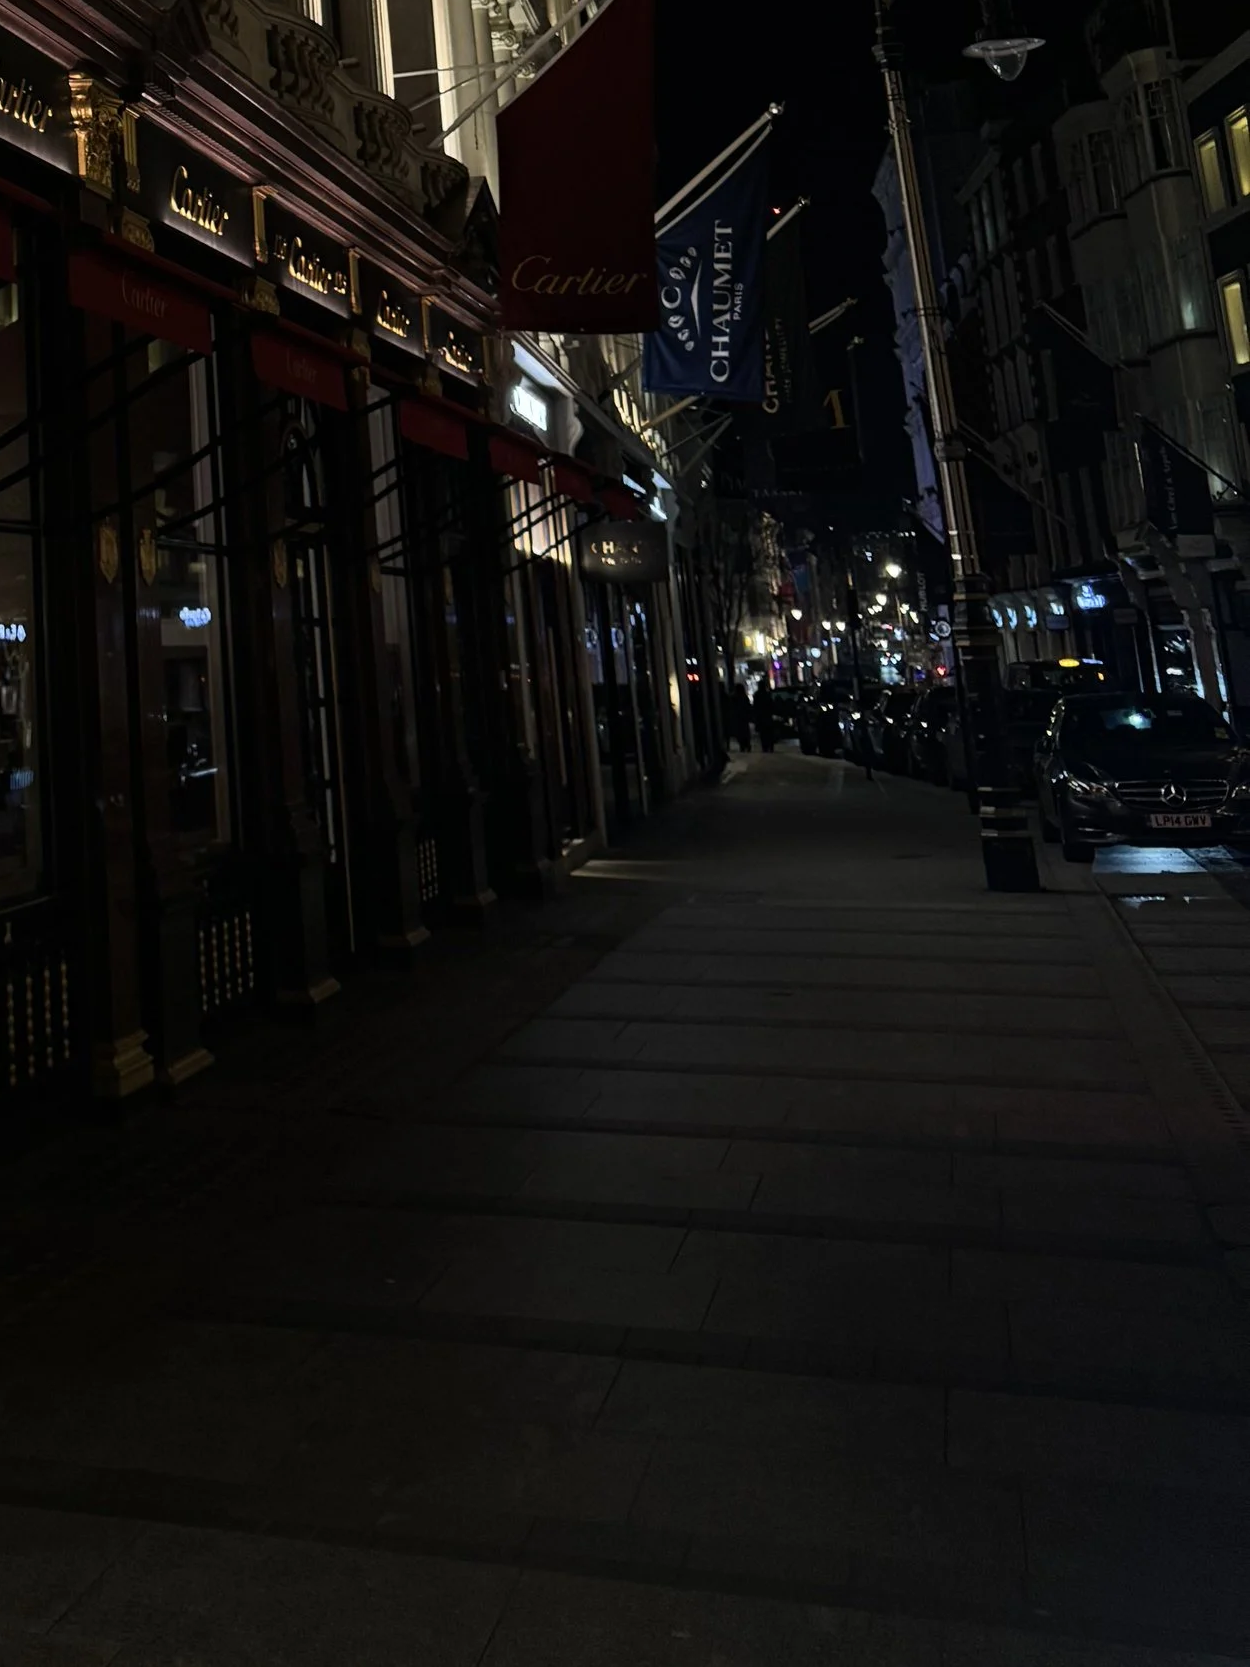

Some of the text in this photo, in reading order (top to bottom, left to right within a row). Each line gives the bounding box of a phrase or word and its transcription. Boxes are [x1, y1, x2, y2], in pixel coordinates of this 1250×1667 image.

[168, 164, 230, 236] Cartier
[121, 270, 168, 319] Cartier
[510, 254, 648, 297] Cartier
[709, 219, 733, 383] CHAUMET
[733, 282, 744, 321] PARIS
